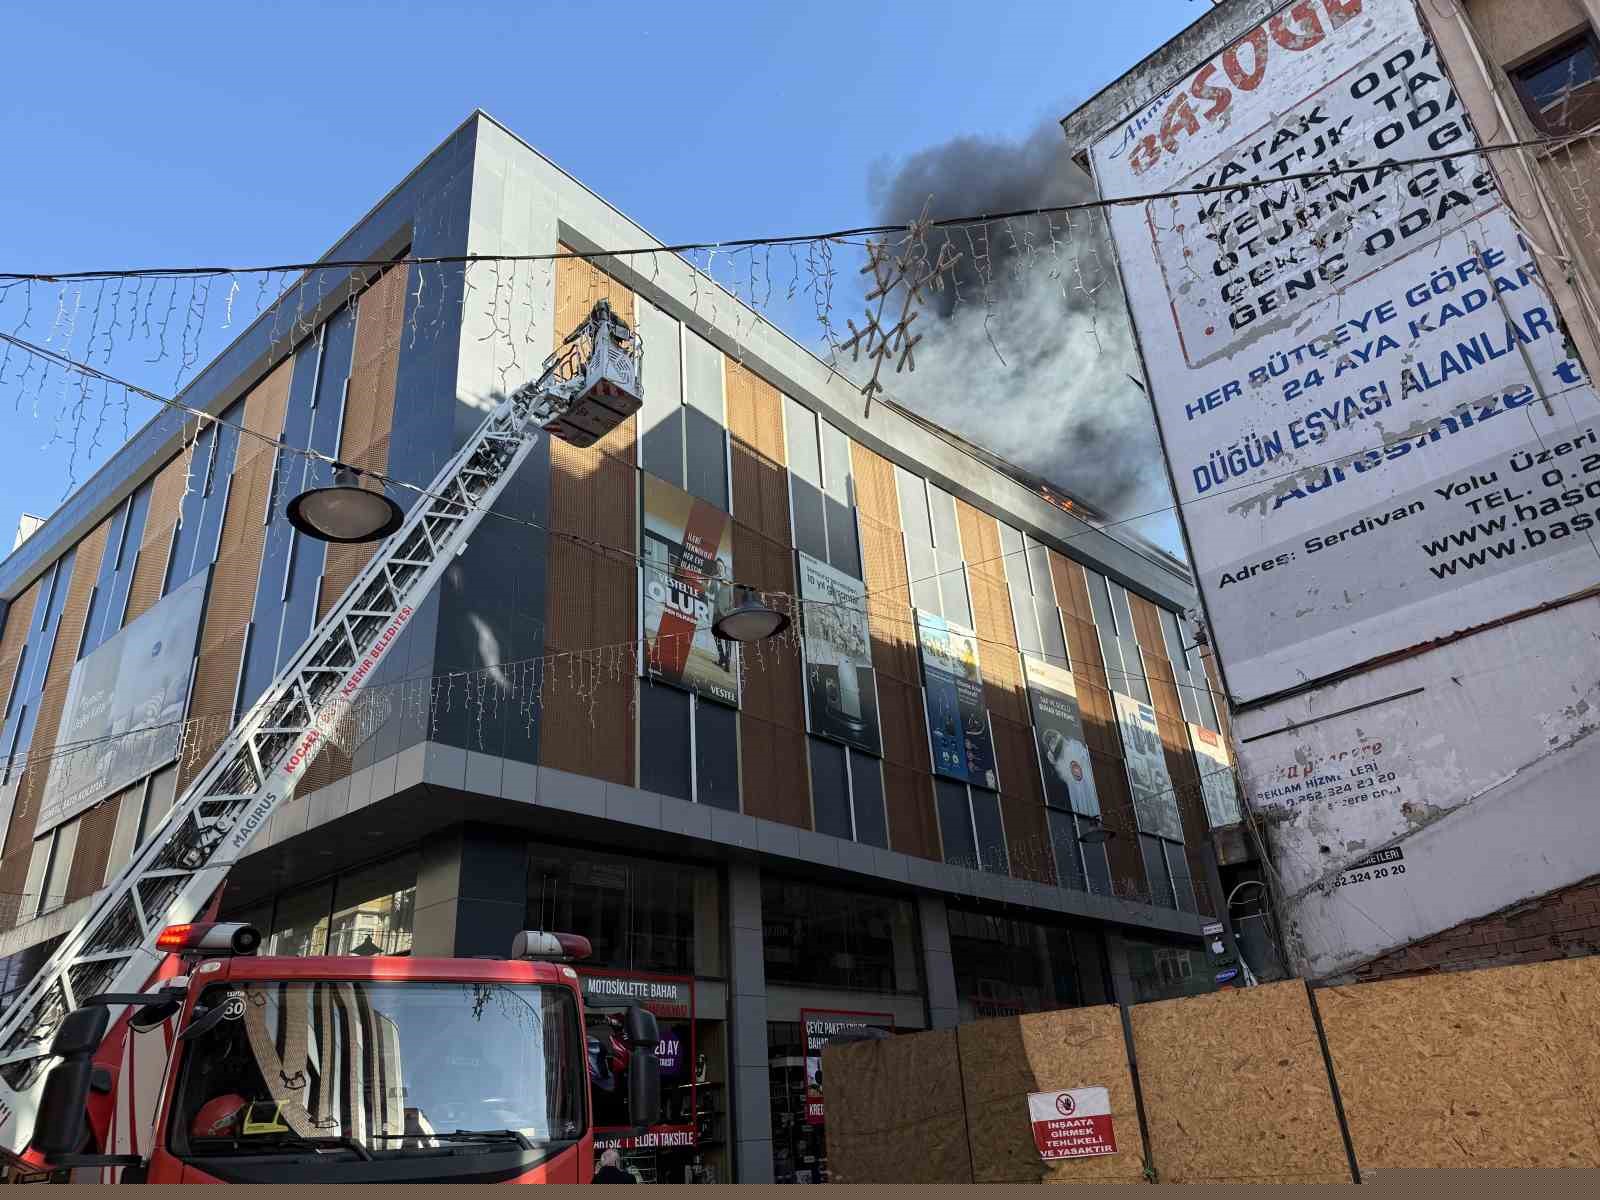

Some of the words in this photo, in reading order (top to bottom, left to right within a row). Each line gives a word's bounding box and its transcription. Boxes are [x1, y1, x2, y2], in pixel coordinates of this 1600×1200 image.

[1192, 106, 1330, 195] YATAK
[1197, 115, 1353, 224] KOLTUK
[1373, 61, 1447, 112] TA
[1229, 253, 1348, 330] GENÇ
[1185, 380, 1242, 420] HER
[1248, 300, 1398, 389] BÜTÇEYE
[1404, 247, 1505, 307] GÖRE
[1283, 367, 1325, 401] 24
[1333, 334, 1400, 379] AYA
[1192, 430, 1284, 494] DÜĞÜN
[1288, 380, 1392, 449] EŞYASI
[1401, 306, 1555, 400] ALANLAR
[1218, 552, 1296, 589] Adres:
[1304, 500, 1425, 555] Serdivan
[1434, 470, 1498, 501] Yolu
[1509, 428, 1598, 473] Üzeri
[1465, 487, 1533, 514] TEL.
[710, 685, 736, 701] VESTEL
[1378, 772, 1396, 783] 20
[233, 792, 276, 849] MAGIRUS
[1374, 867, 1389, 879] 20
[1391, 864, 1406, 875] 20
[588, 978, 649, 998] MOTOSİKLETTE
[651, 984, 677, 999] BAHAR
[667, 1040, 679, 1055] AY
[1047, 1118, 1094, 1130] İNŞAATA
[1050, 1127, 1094, 1138] GİRMEK
[634, 1132, 659, 1148] ELDEN
[659, 1130, 694, 1146] TAKSİTLE
[1046, 1135, 1104, 1147] TEHLİKELİ
[1040, 1149, 1055, 1157] VE
[1057, 1145, 1113, 1156] YASAKTIR
